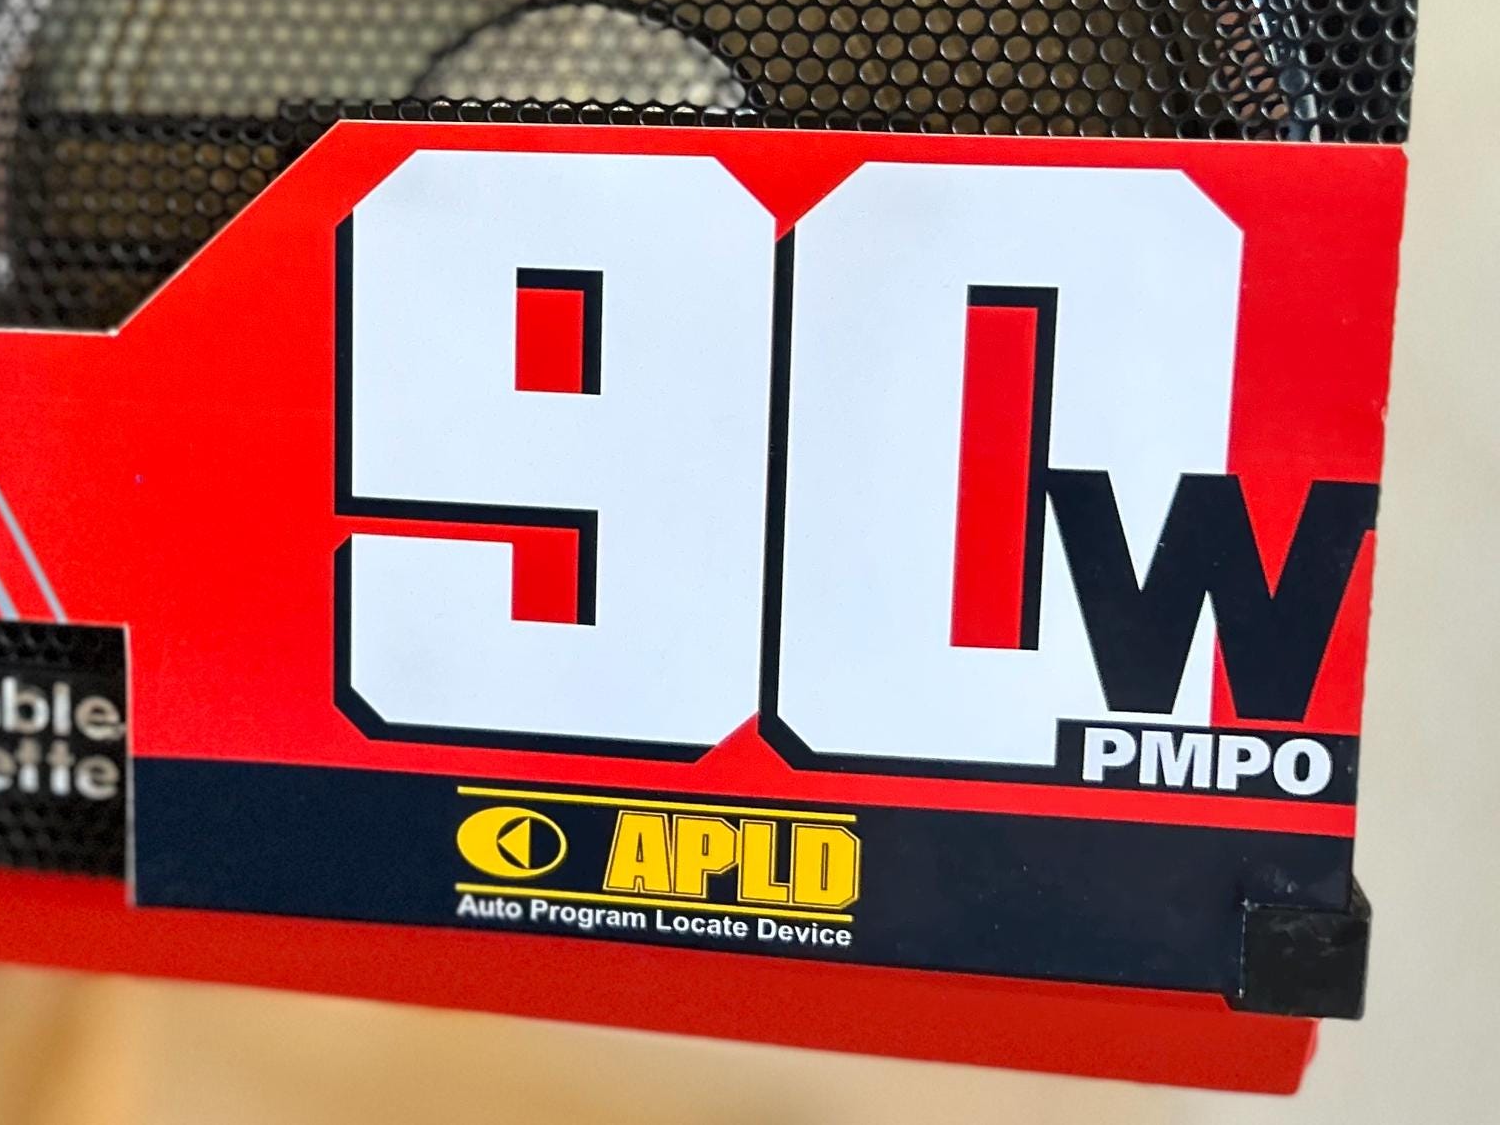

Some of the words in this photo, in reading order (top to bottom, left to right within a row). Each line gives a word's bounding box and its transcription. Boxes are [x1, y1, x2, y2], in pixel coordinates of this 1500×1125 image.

[335, 149, 1243, 770] 90
[1047, 468, 1380, 723] W
[1081, 726, 1333, 797] PMPO
[603, 809, 861, 910] APLD
[457, 893, 523, 920] Auto
[530, 899, 647, 933] Program
[656, 910, 748, 938] Locate
[758, 918, 853, 946] Device
